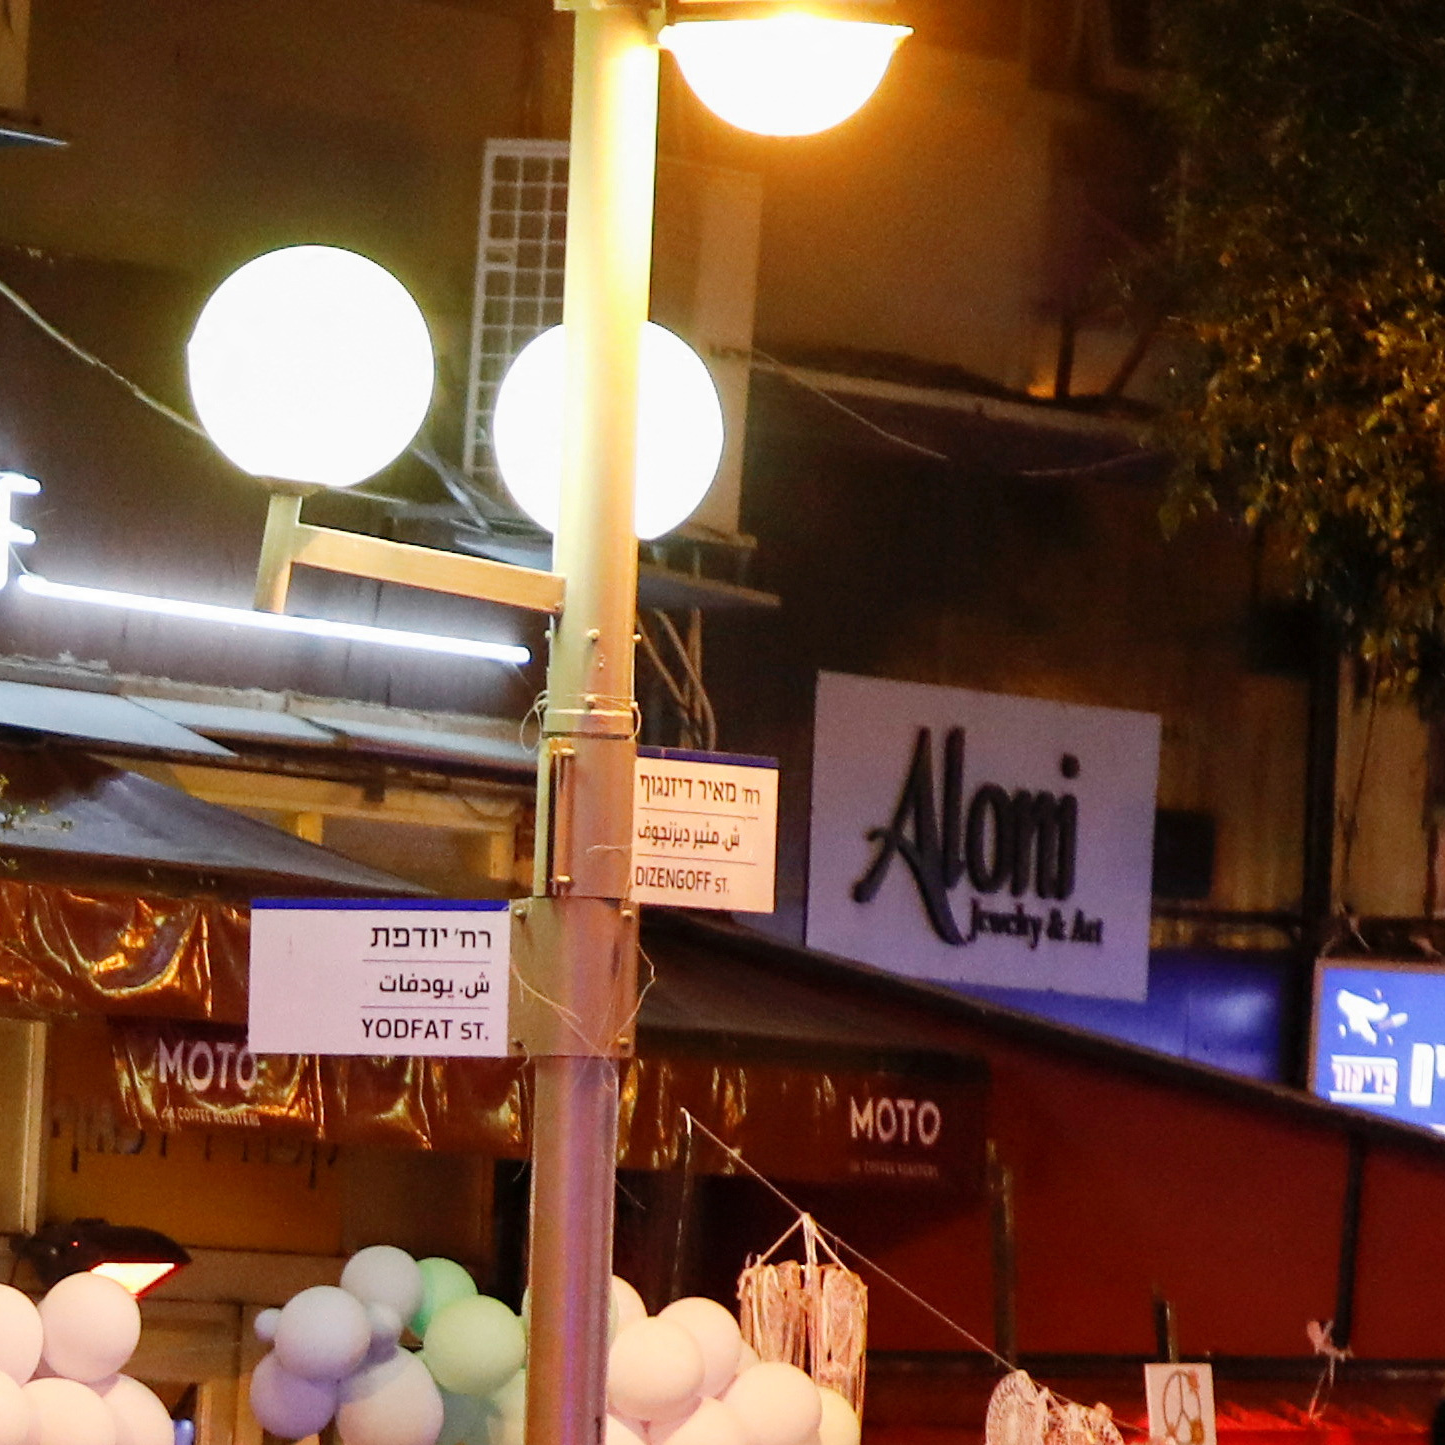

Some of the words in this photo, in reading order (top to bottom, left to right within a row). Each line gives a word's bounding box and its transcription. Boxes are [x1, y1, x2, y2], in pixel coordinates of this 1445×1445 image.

[639, 773, 693, 803] דיזנגוף
[698, 780, 737, 802] מאיר
[852, 726, 1081, 948] Aloni
[635, 866, 712, 891] DIZENGOFF
[715, 877, 730, 894] ST.
[370, 926, 449, 949] יודפת
[455, 928, 492, 949] רח'
[378, 972, 456, 1000] يودفات
[361, 1017, 454, 1040] YODFAT
[460, 1021, 490, 1042] ST.
[158, 1037, 258, 1092] MOTO
[850, 1096, 941, 1145] MOTO
